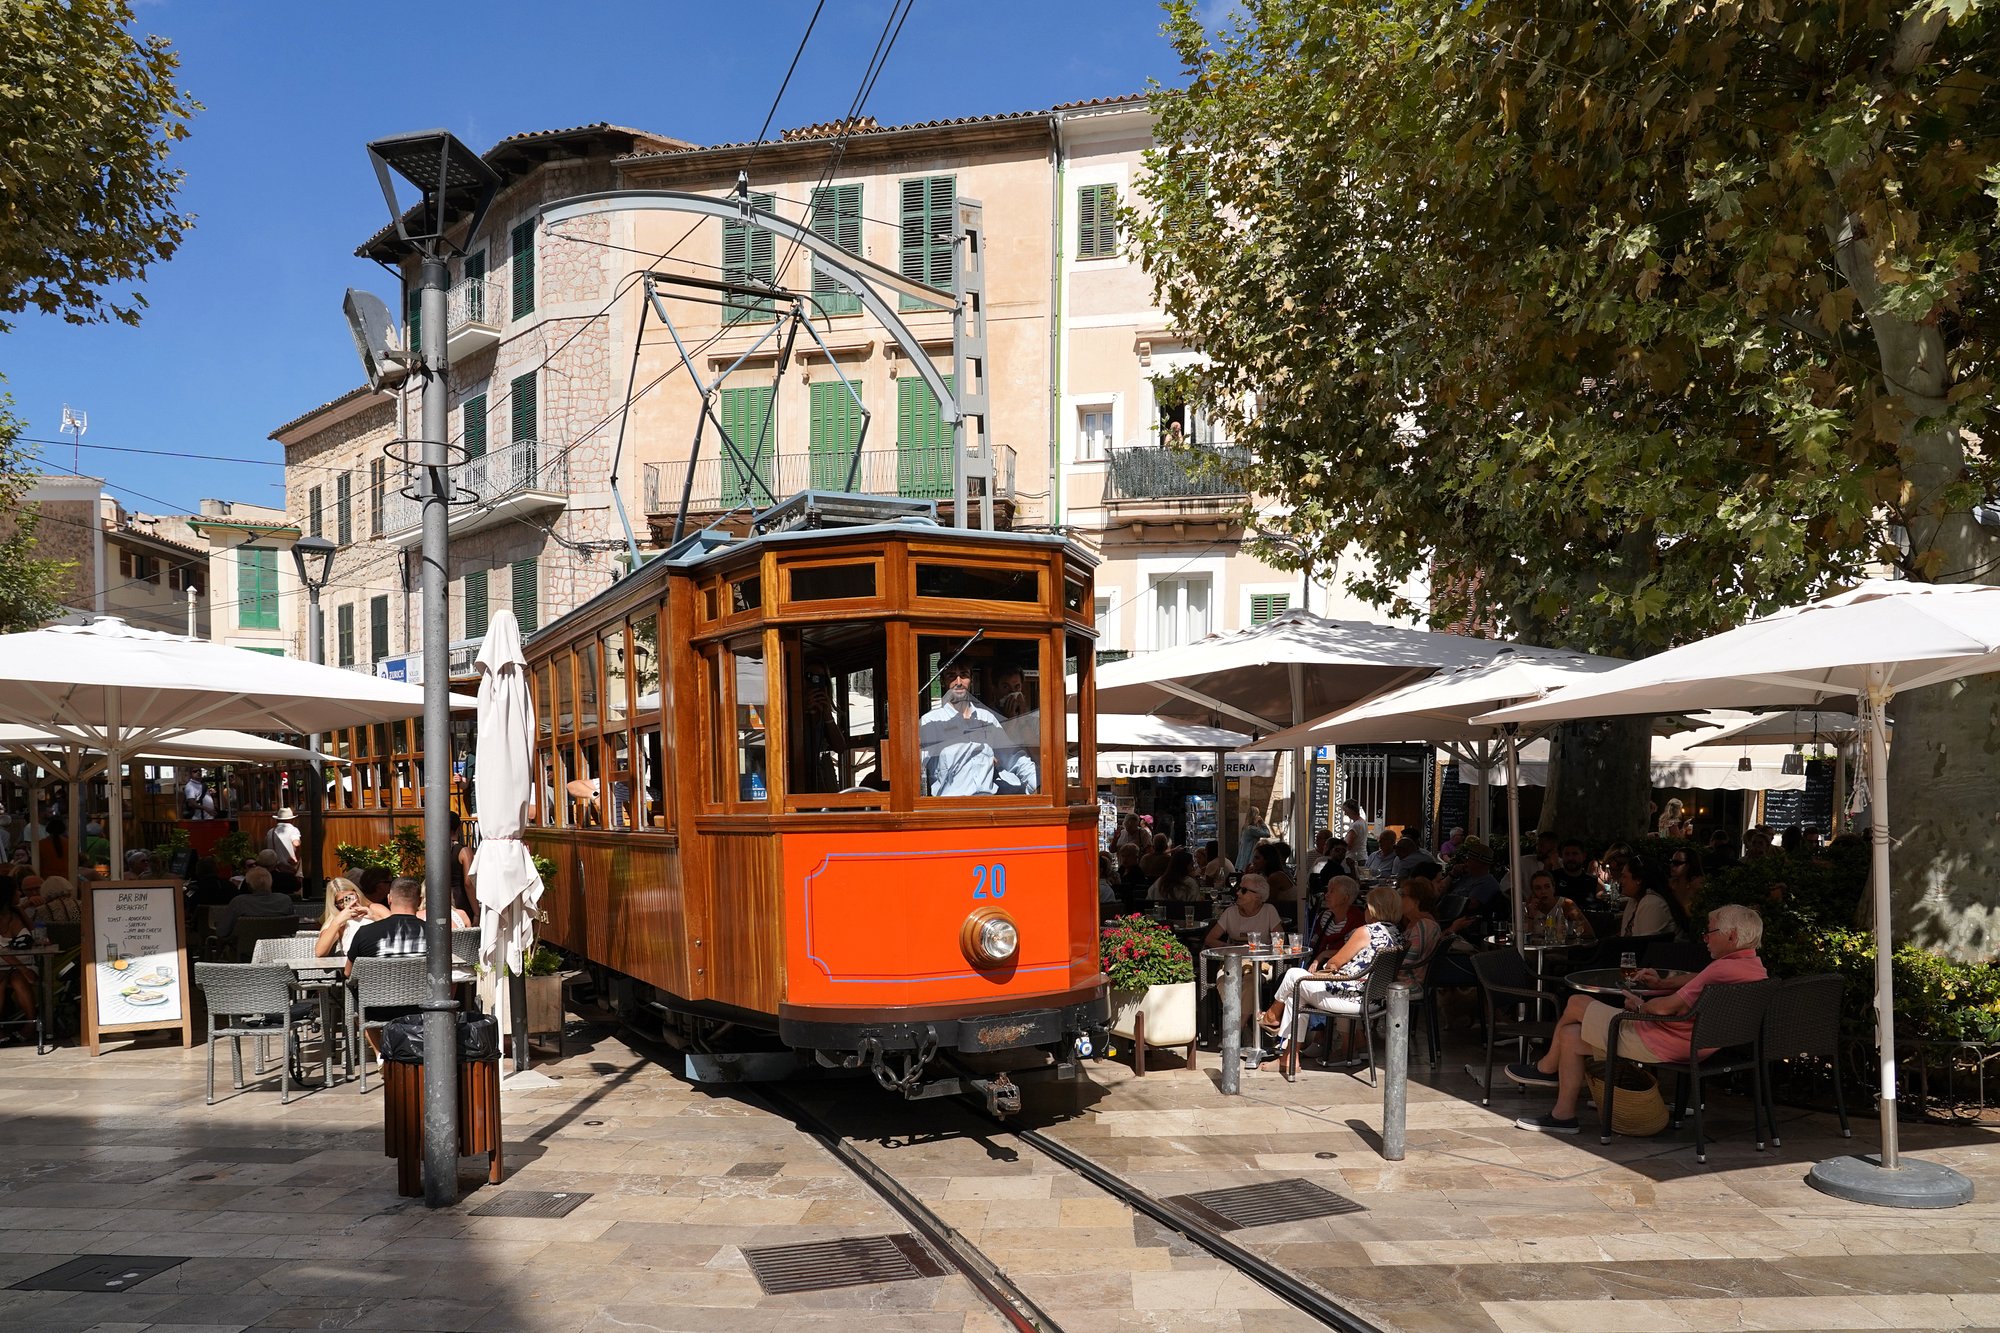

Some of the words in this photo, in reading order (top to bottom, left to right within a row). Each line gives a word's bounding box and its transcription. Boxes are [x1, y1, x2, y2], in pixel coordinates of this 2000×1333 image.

[1133, 764, 1182, 774] TABACS
[1201, 763, 1256, 772] PARERIA
[972, 863, 1006, 899] 20
[118, 893, 132, 902] BAR
